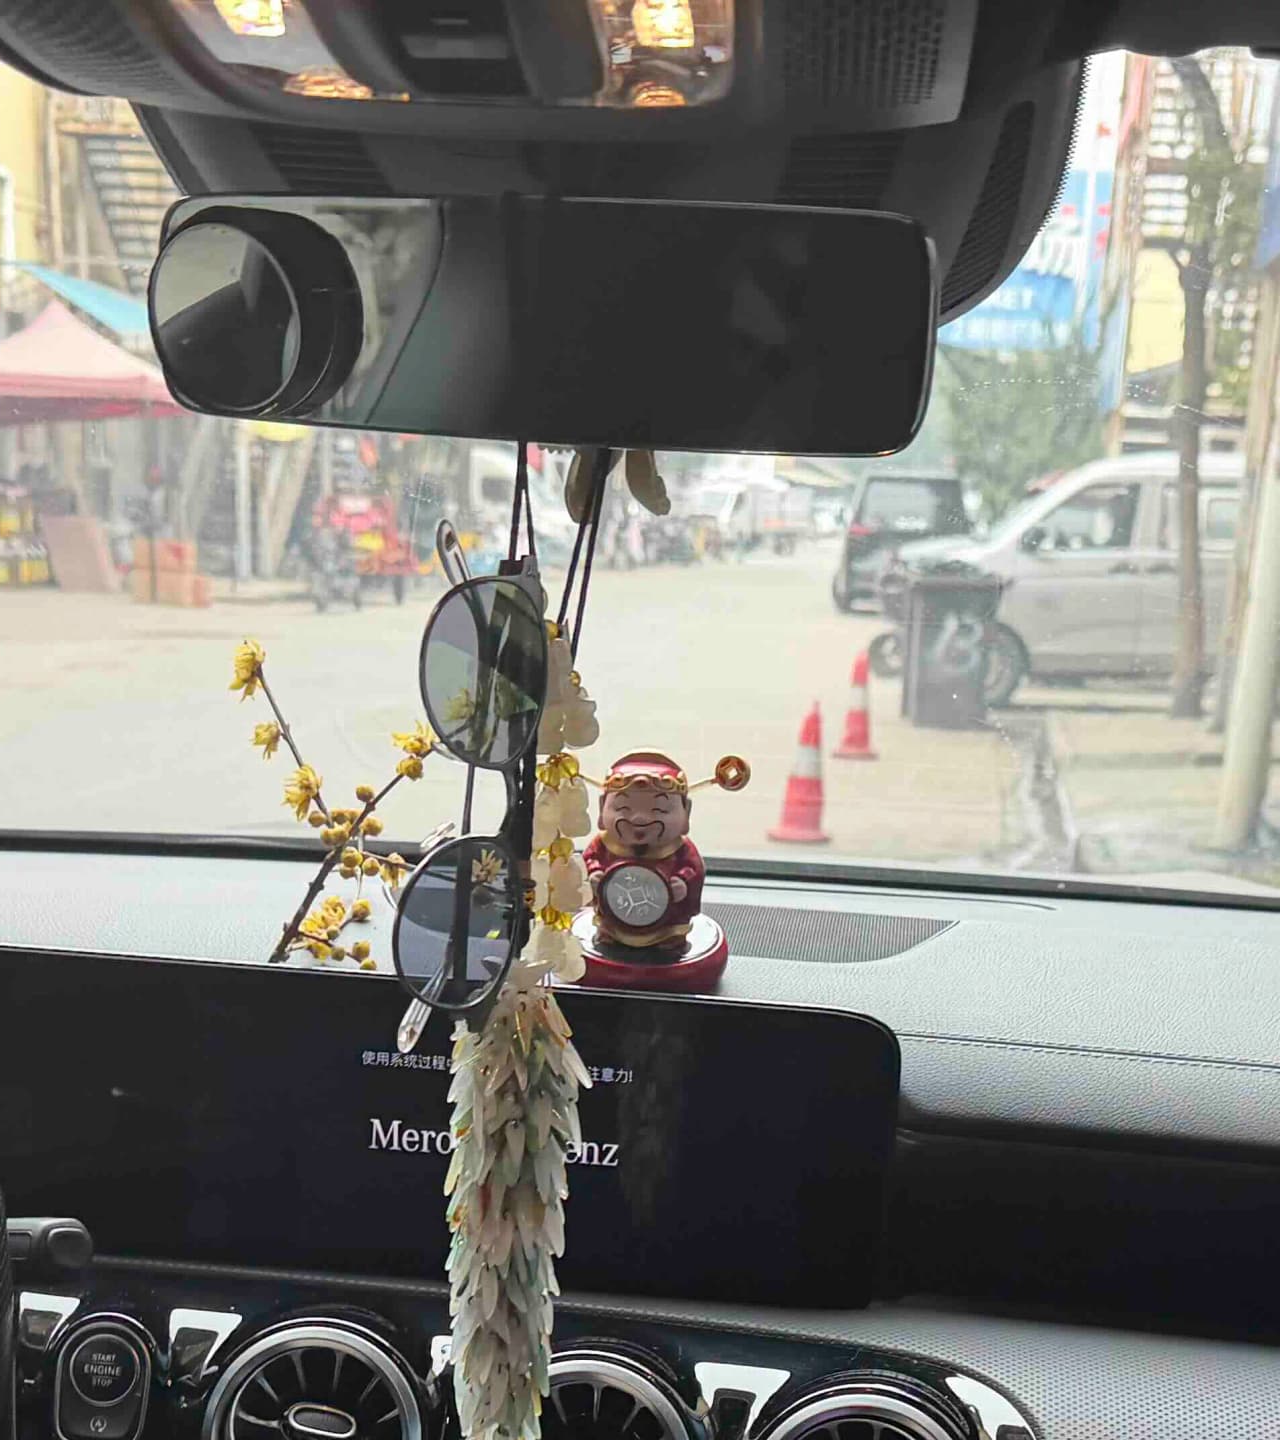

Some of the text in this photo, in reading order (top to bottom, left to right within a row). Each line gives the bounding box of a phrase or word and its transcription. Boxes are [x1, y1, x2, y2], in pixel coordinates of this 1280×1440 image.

[92, 1352, 117, 1361] START
[84, 1363, 121, 1376] ENGINE
[92, 1378, 113, 1386] STOP
